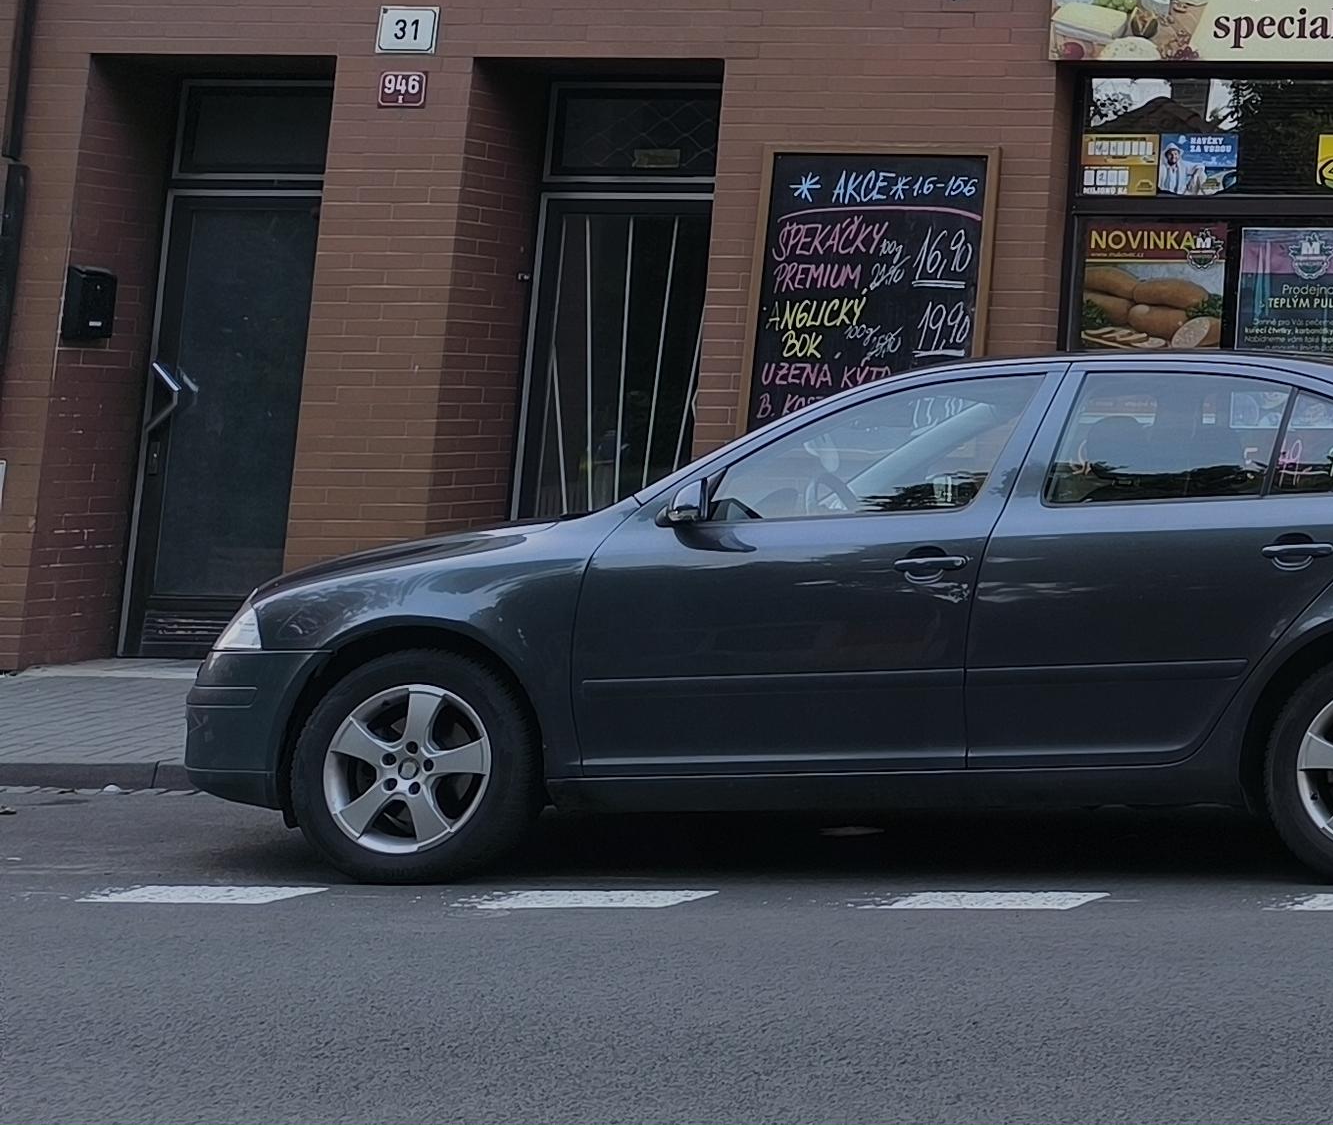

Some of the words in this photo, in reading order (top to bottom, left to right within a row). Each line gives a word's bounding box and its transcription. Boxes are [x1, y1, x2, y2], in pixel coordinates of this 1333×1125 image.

[394, 19, 420, 41] 31
[384, 75, 420, 94] 946
[832, 170, 896, 204] AKCE
[1091, 230, 1195, 250] NOVINKA
[773, 262, 862, 294] PREMIUM
[1268, 296, 1310, 309] TEPLÝM
[782, 332, 823, 359] BOK
